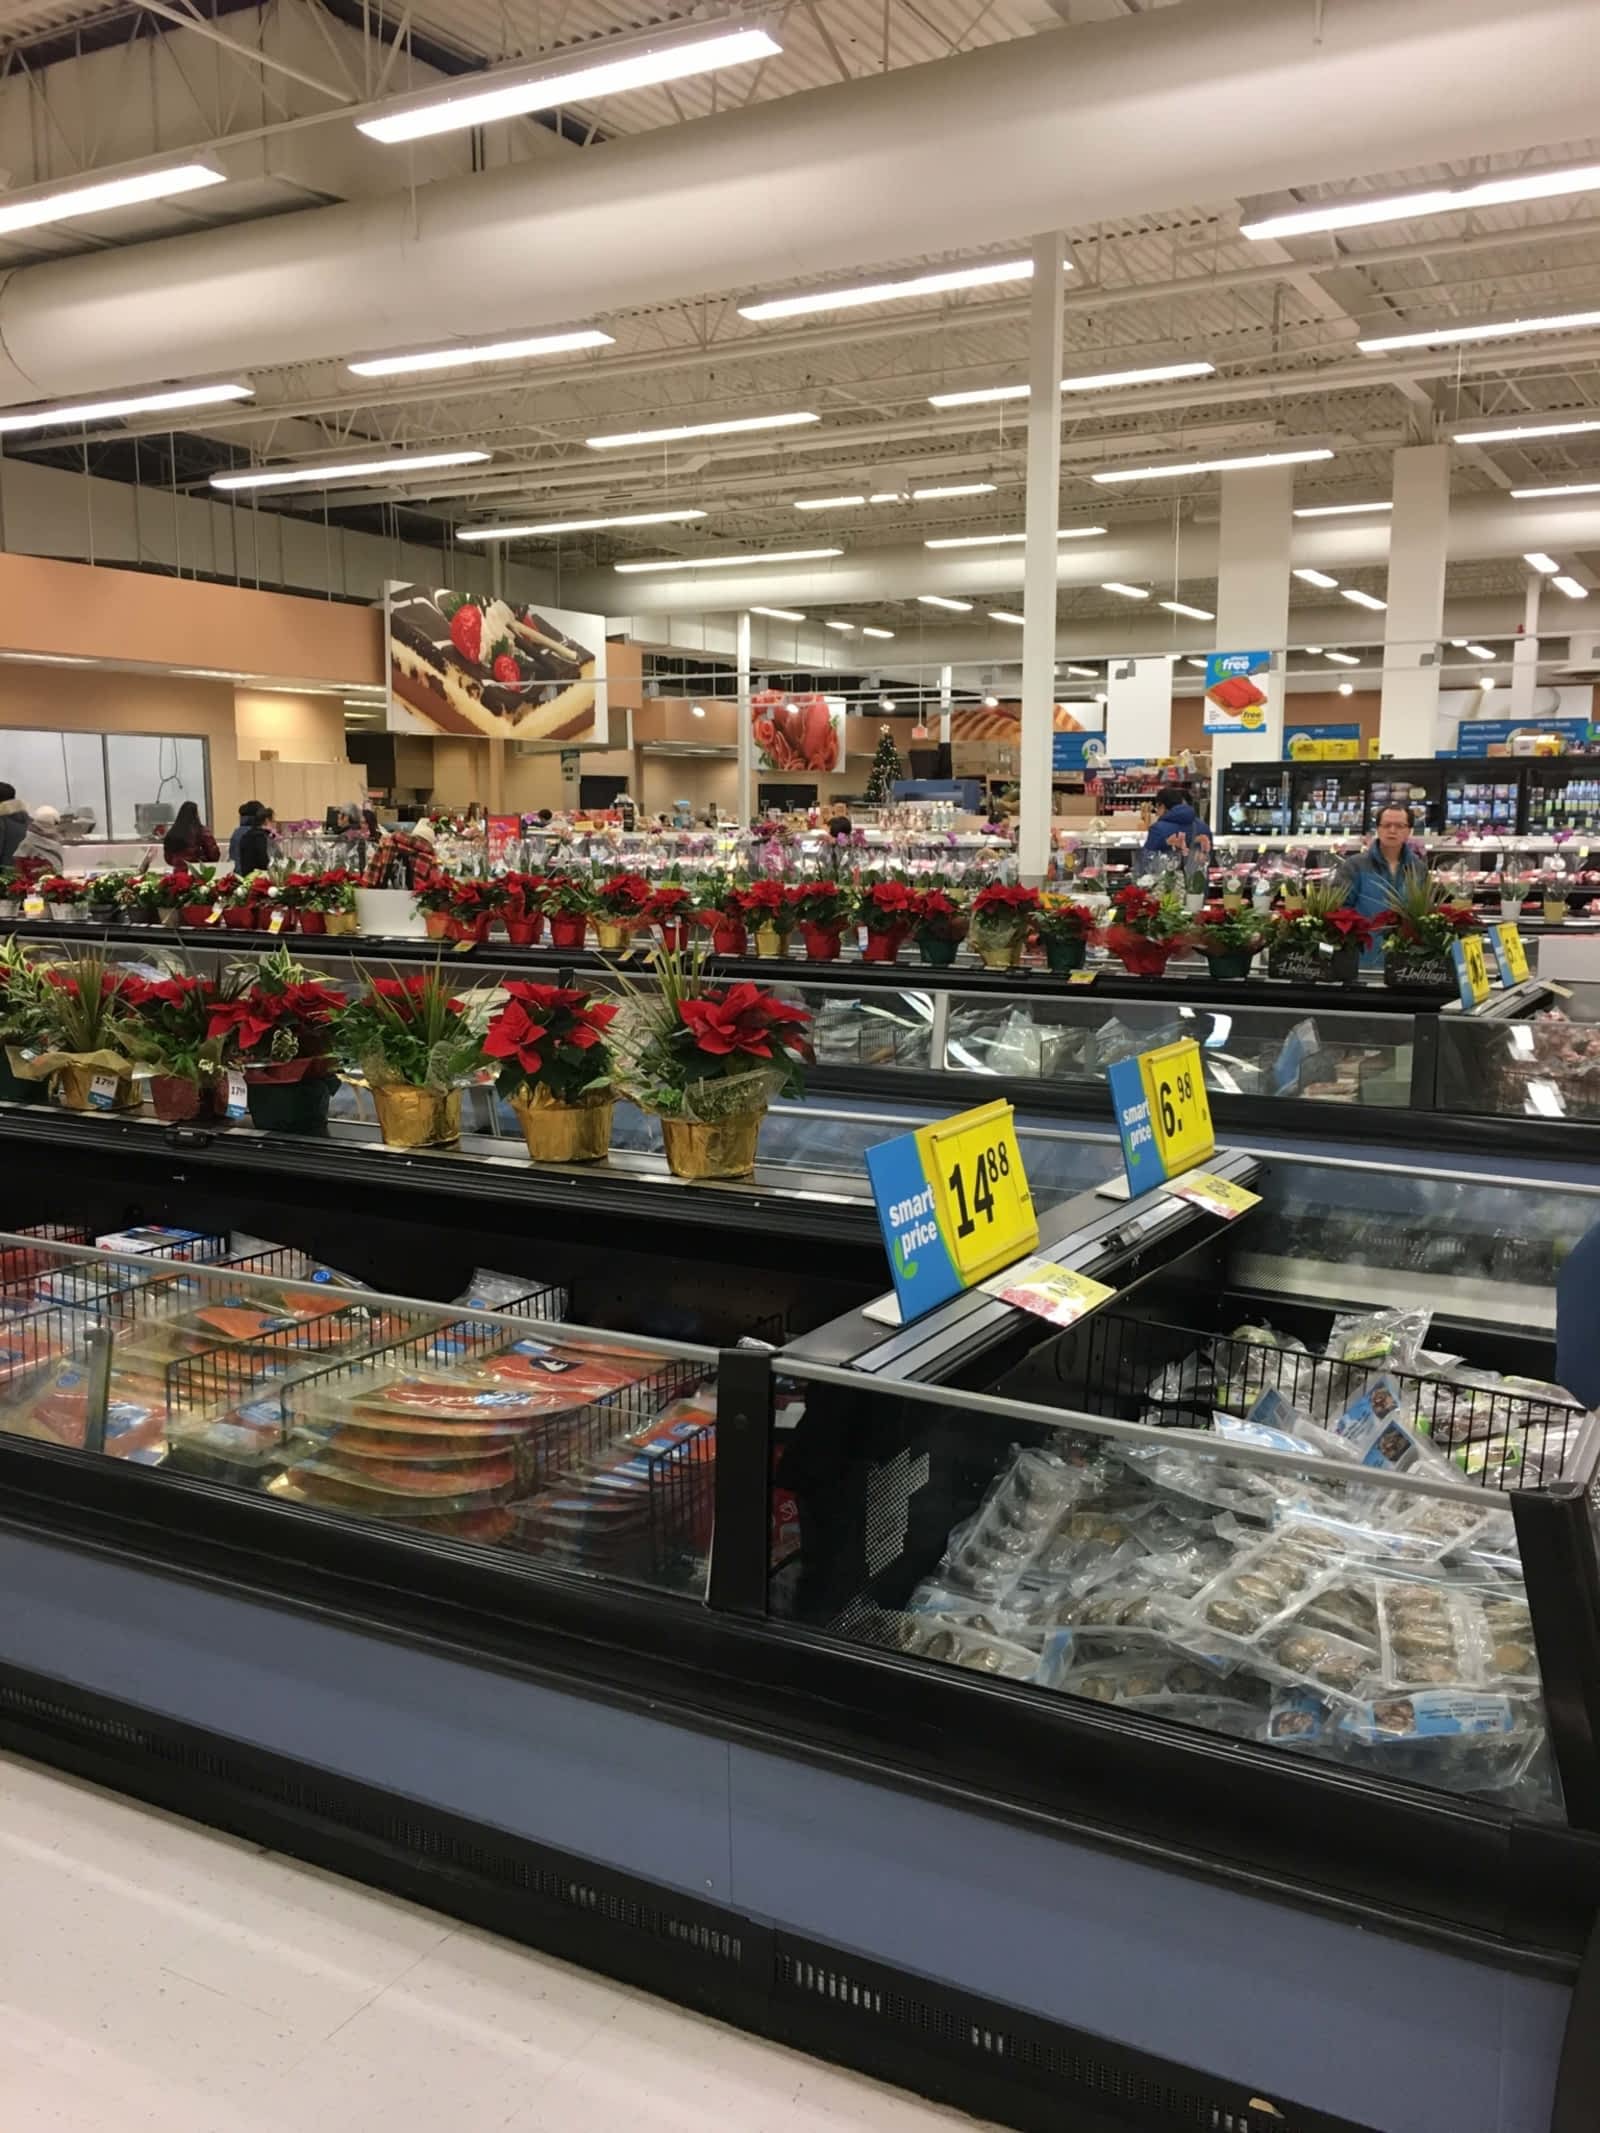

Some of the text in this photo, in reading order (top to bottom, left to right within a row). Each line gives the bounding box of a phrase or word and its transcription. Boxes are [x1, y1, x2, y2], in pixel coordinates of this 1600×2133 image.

[1395, 968, 1447, 984] Holidays
[1123, 1098, 1151, 1126] smart
[1130, 1123, 1152, 1151] price
[889, 1184, 936, 1228] smart
[902, 1220, 937, 1260] price
